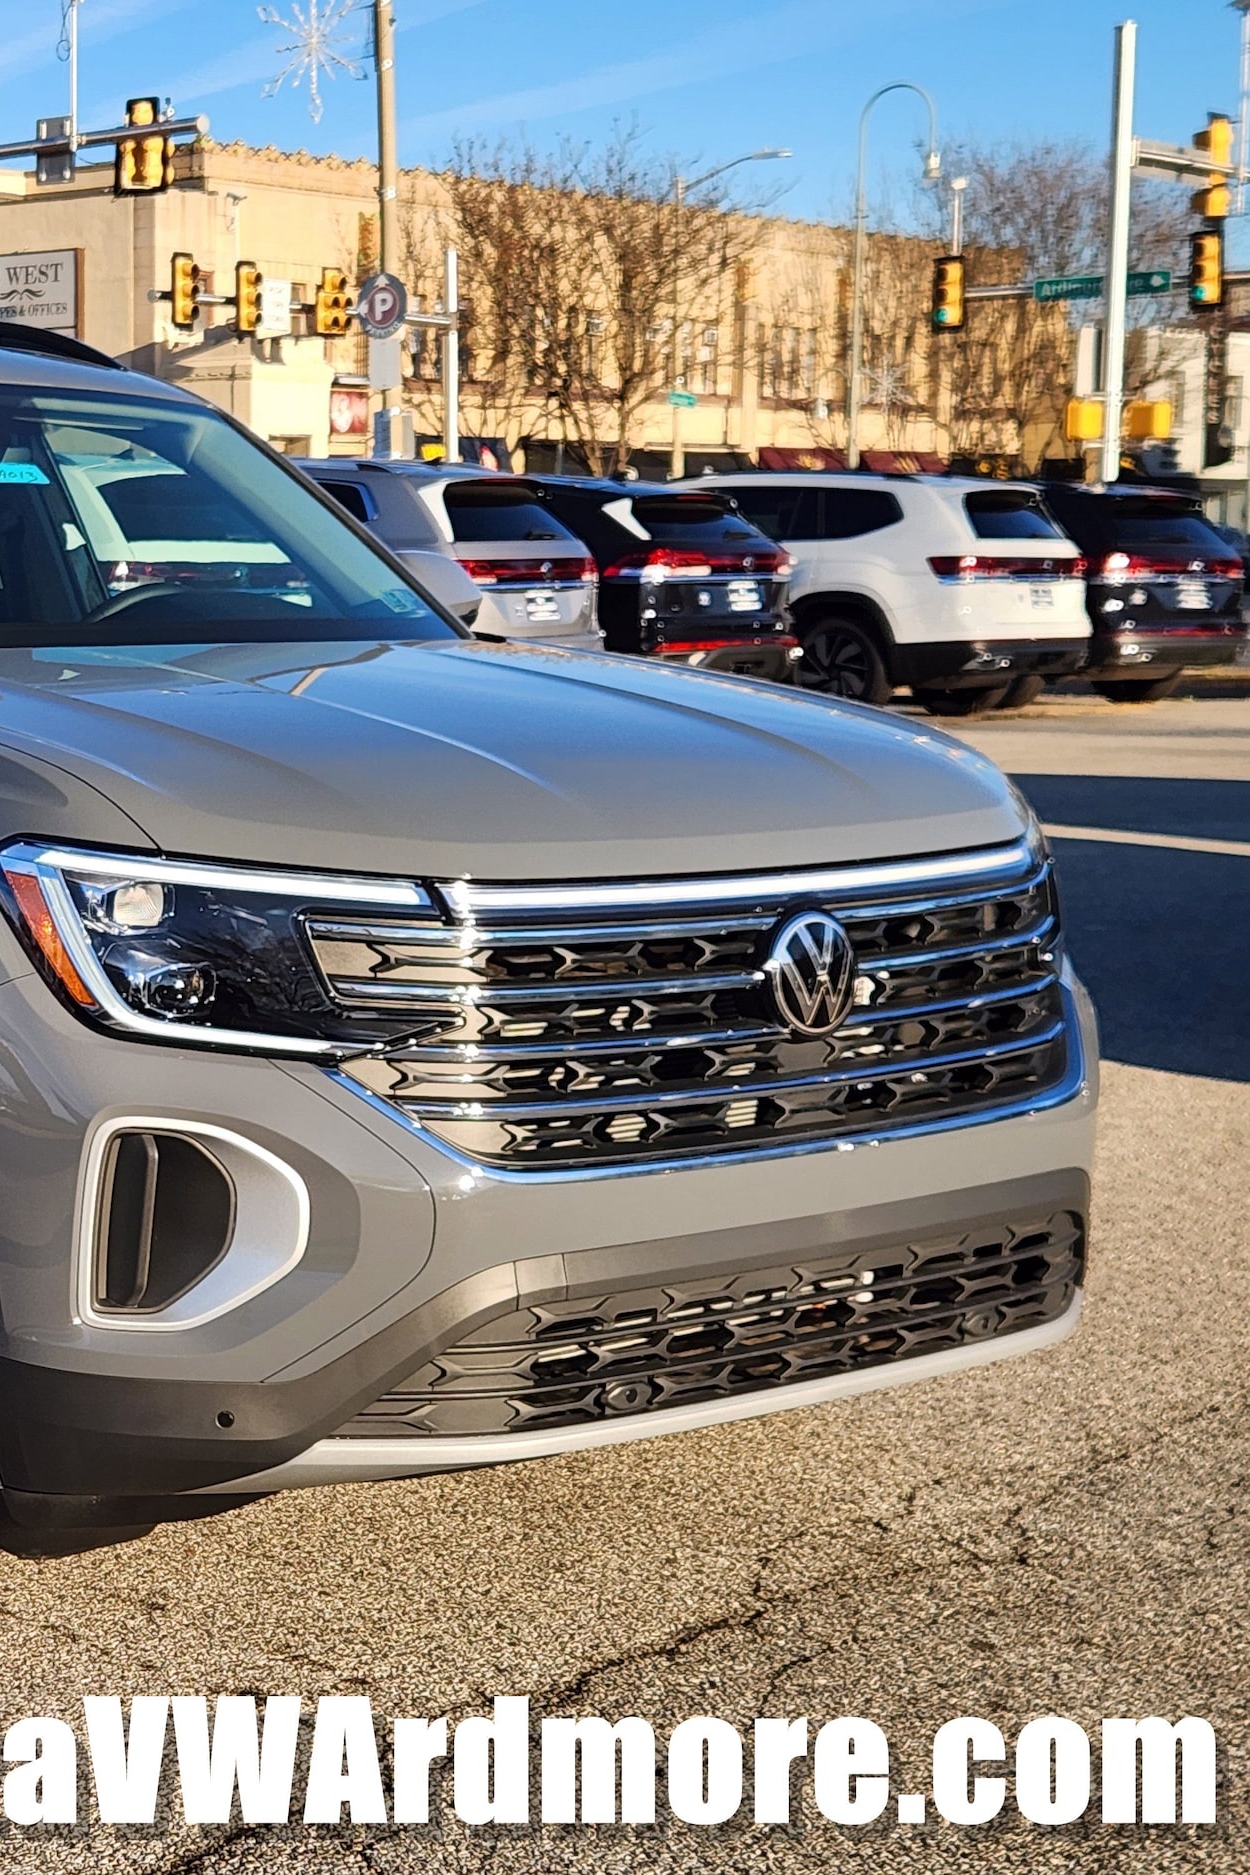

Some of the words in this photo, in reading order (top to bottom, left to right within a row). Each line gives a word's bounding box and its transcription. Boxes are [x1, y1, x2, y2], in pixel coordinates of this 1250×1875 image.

[6, 263, 63, 286] WEST
[19, 304, 27, 317] &
[28, 302, 68, 317] OFFICES
[374, 293, 394, 321] P
[776, 917, 852, 1031] VW
